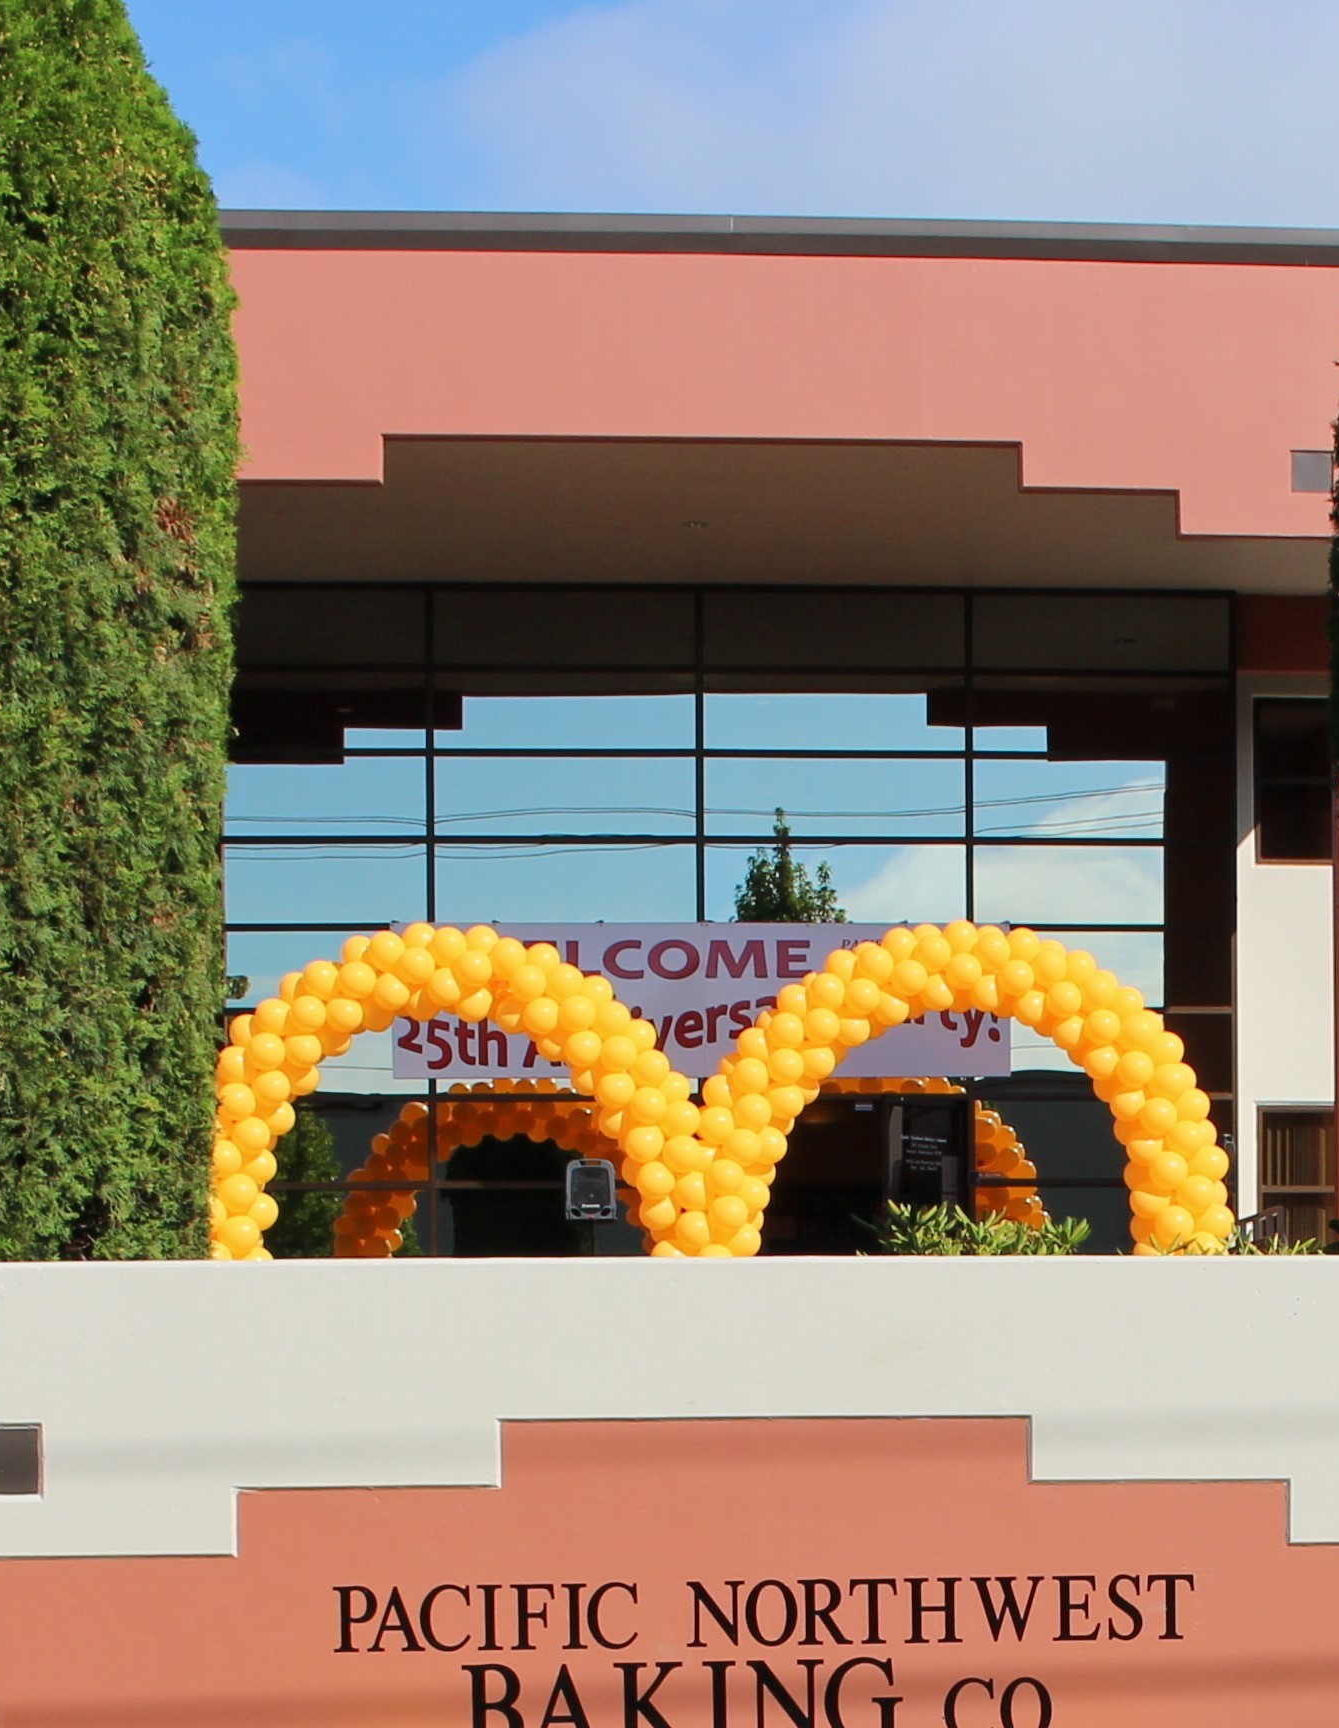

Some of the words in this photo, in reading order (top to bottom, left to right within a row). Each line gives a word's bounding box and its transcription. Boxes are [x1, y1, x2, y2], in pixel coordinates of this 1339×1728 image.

[522, 938, 813, 980] LCOME
[397, 1016, 508, 1070] 25th
[332, 1582, 639, 1653] PACIFIC
[686, 1574, 1195, 1648] NORTHWEST
